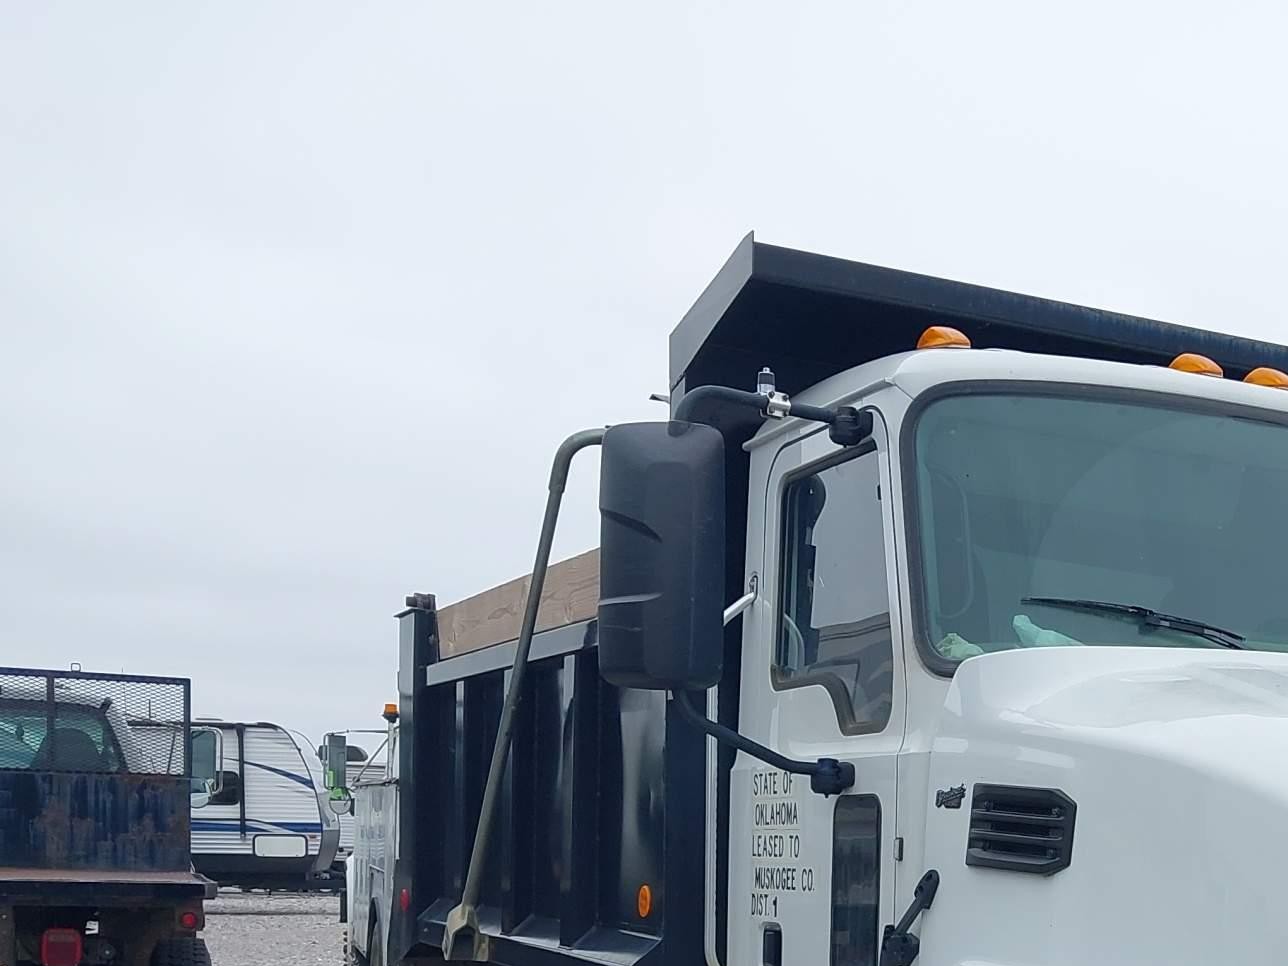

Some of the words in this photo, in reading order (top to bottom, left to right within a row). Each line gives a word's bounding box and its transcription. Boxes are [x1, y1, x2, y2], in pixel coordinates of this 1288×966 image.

[753, 772, 778, 796] STATE
[782, 771, 793, 795] OF
[755, 802, 798, 826] OKLAHOMA
[752, 834, 784, 858] LEASED
[788, 834, 800, 858] TO
[754, 867, 796, 890] MUSKOGEE
[801, 868, 815, 892] CO.
[751, 893, 770, 916] DIST.
[772, 895, 778, 918] 1
